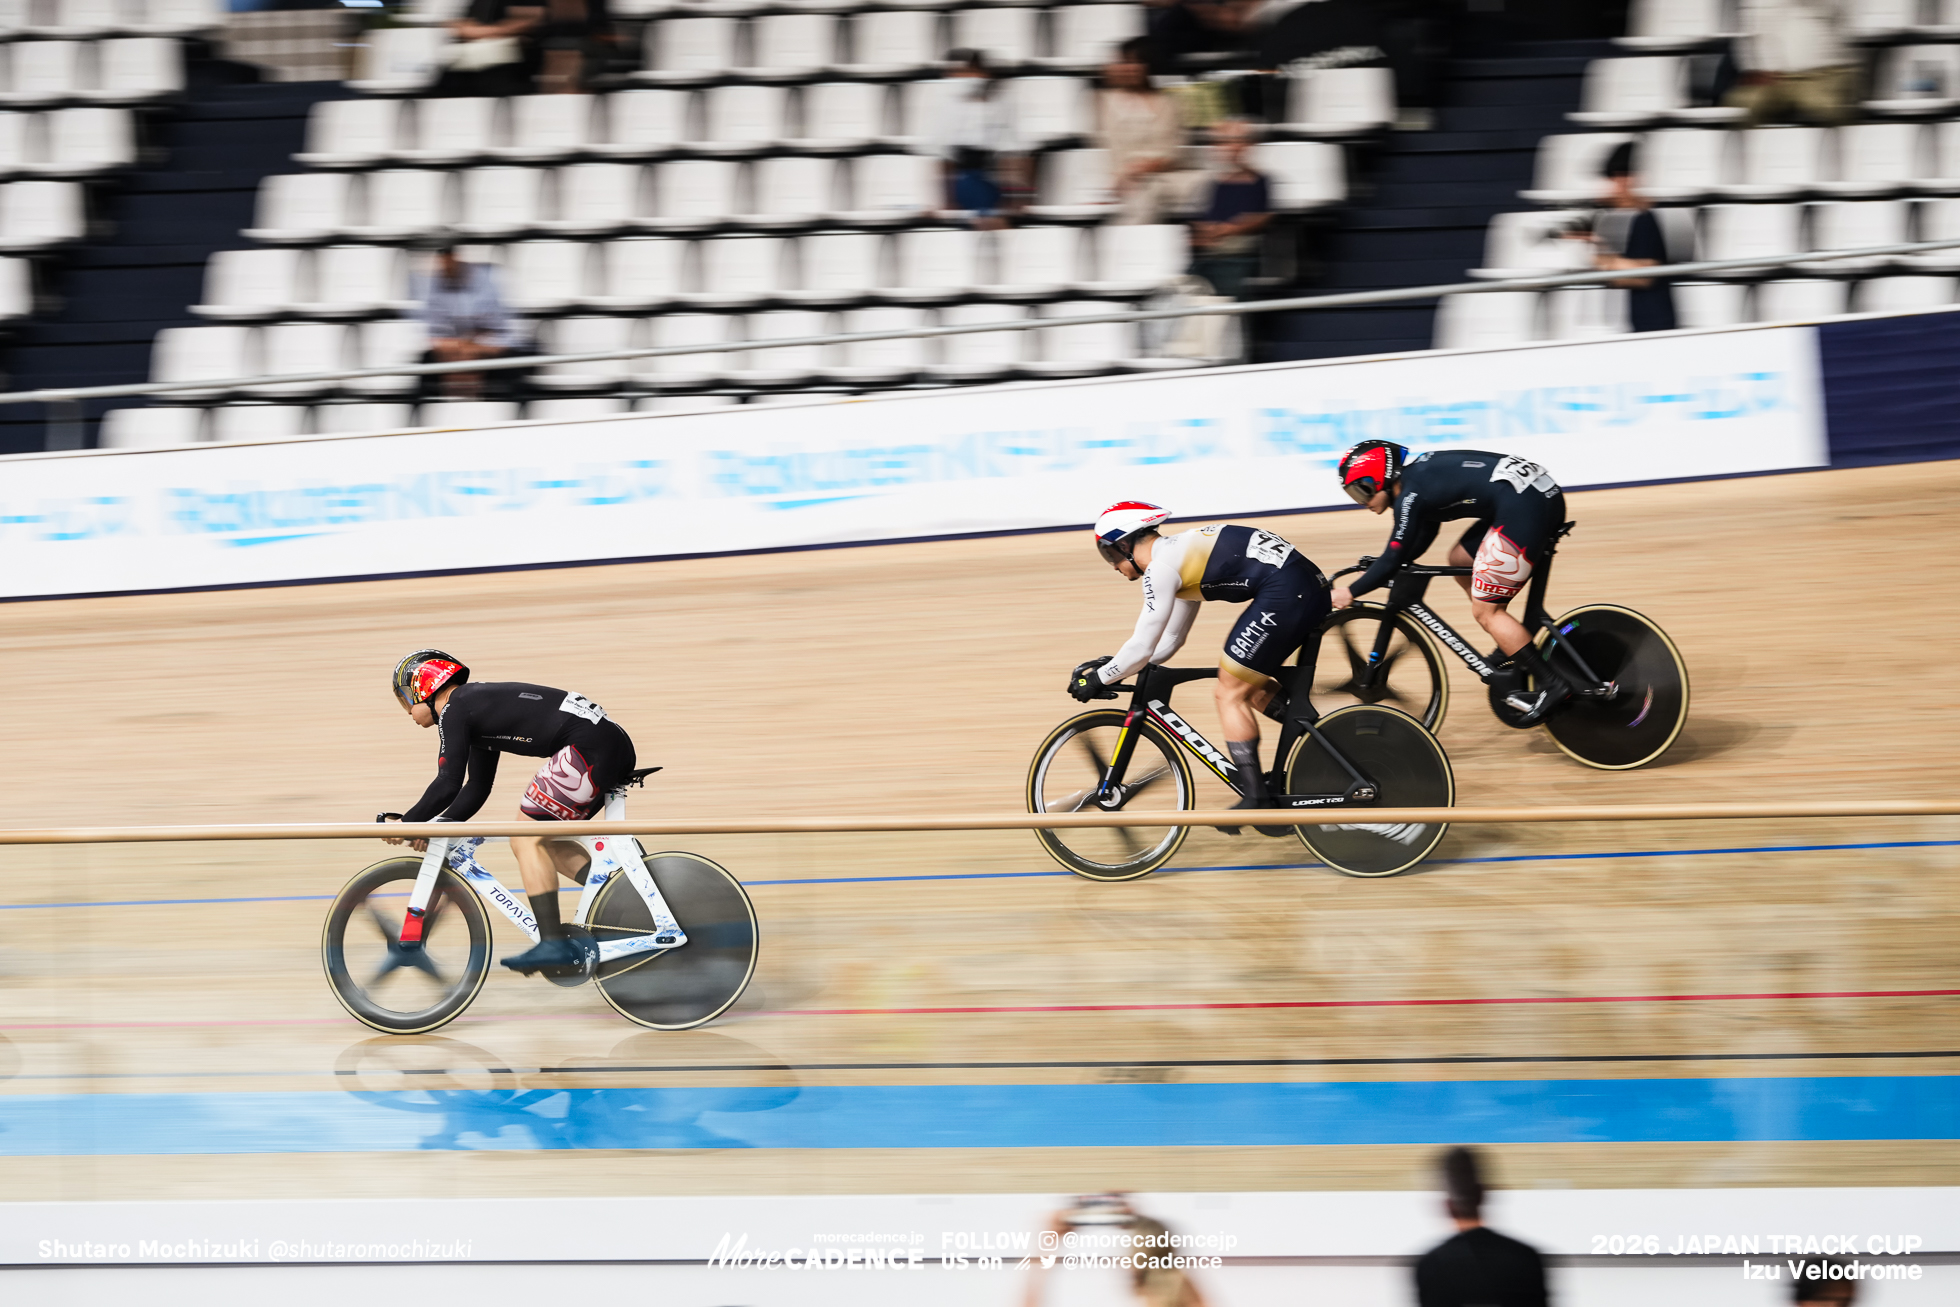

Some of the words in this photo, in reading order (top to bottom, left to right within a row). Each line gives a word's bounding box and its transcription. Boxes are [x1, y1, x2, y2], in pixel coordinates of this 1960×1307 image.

[431, 664, 455, 689] JAPAN
[1147, 699, 1239, 776] LOOK
[1292, 798, 1325, 807] LOOK
